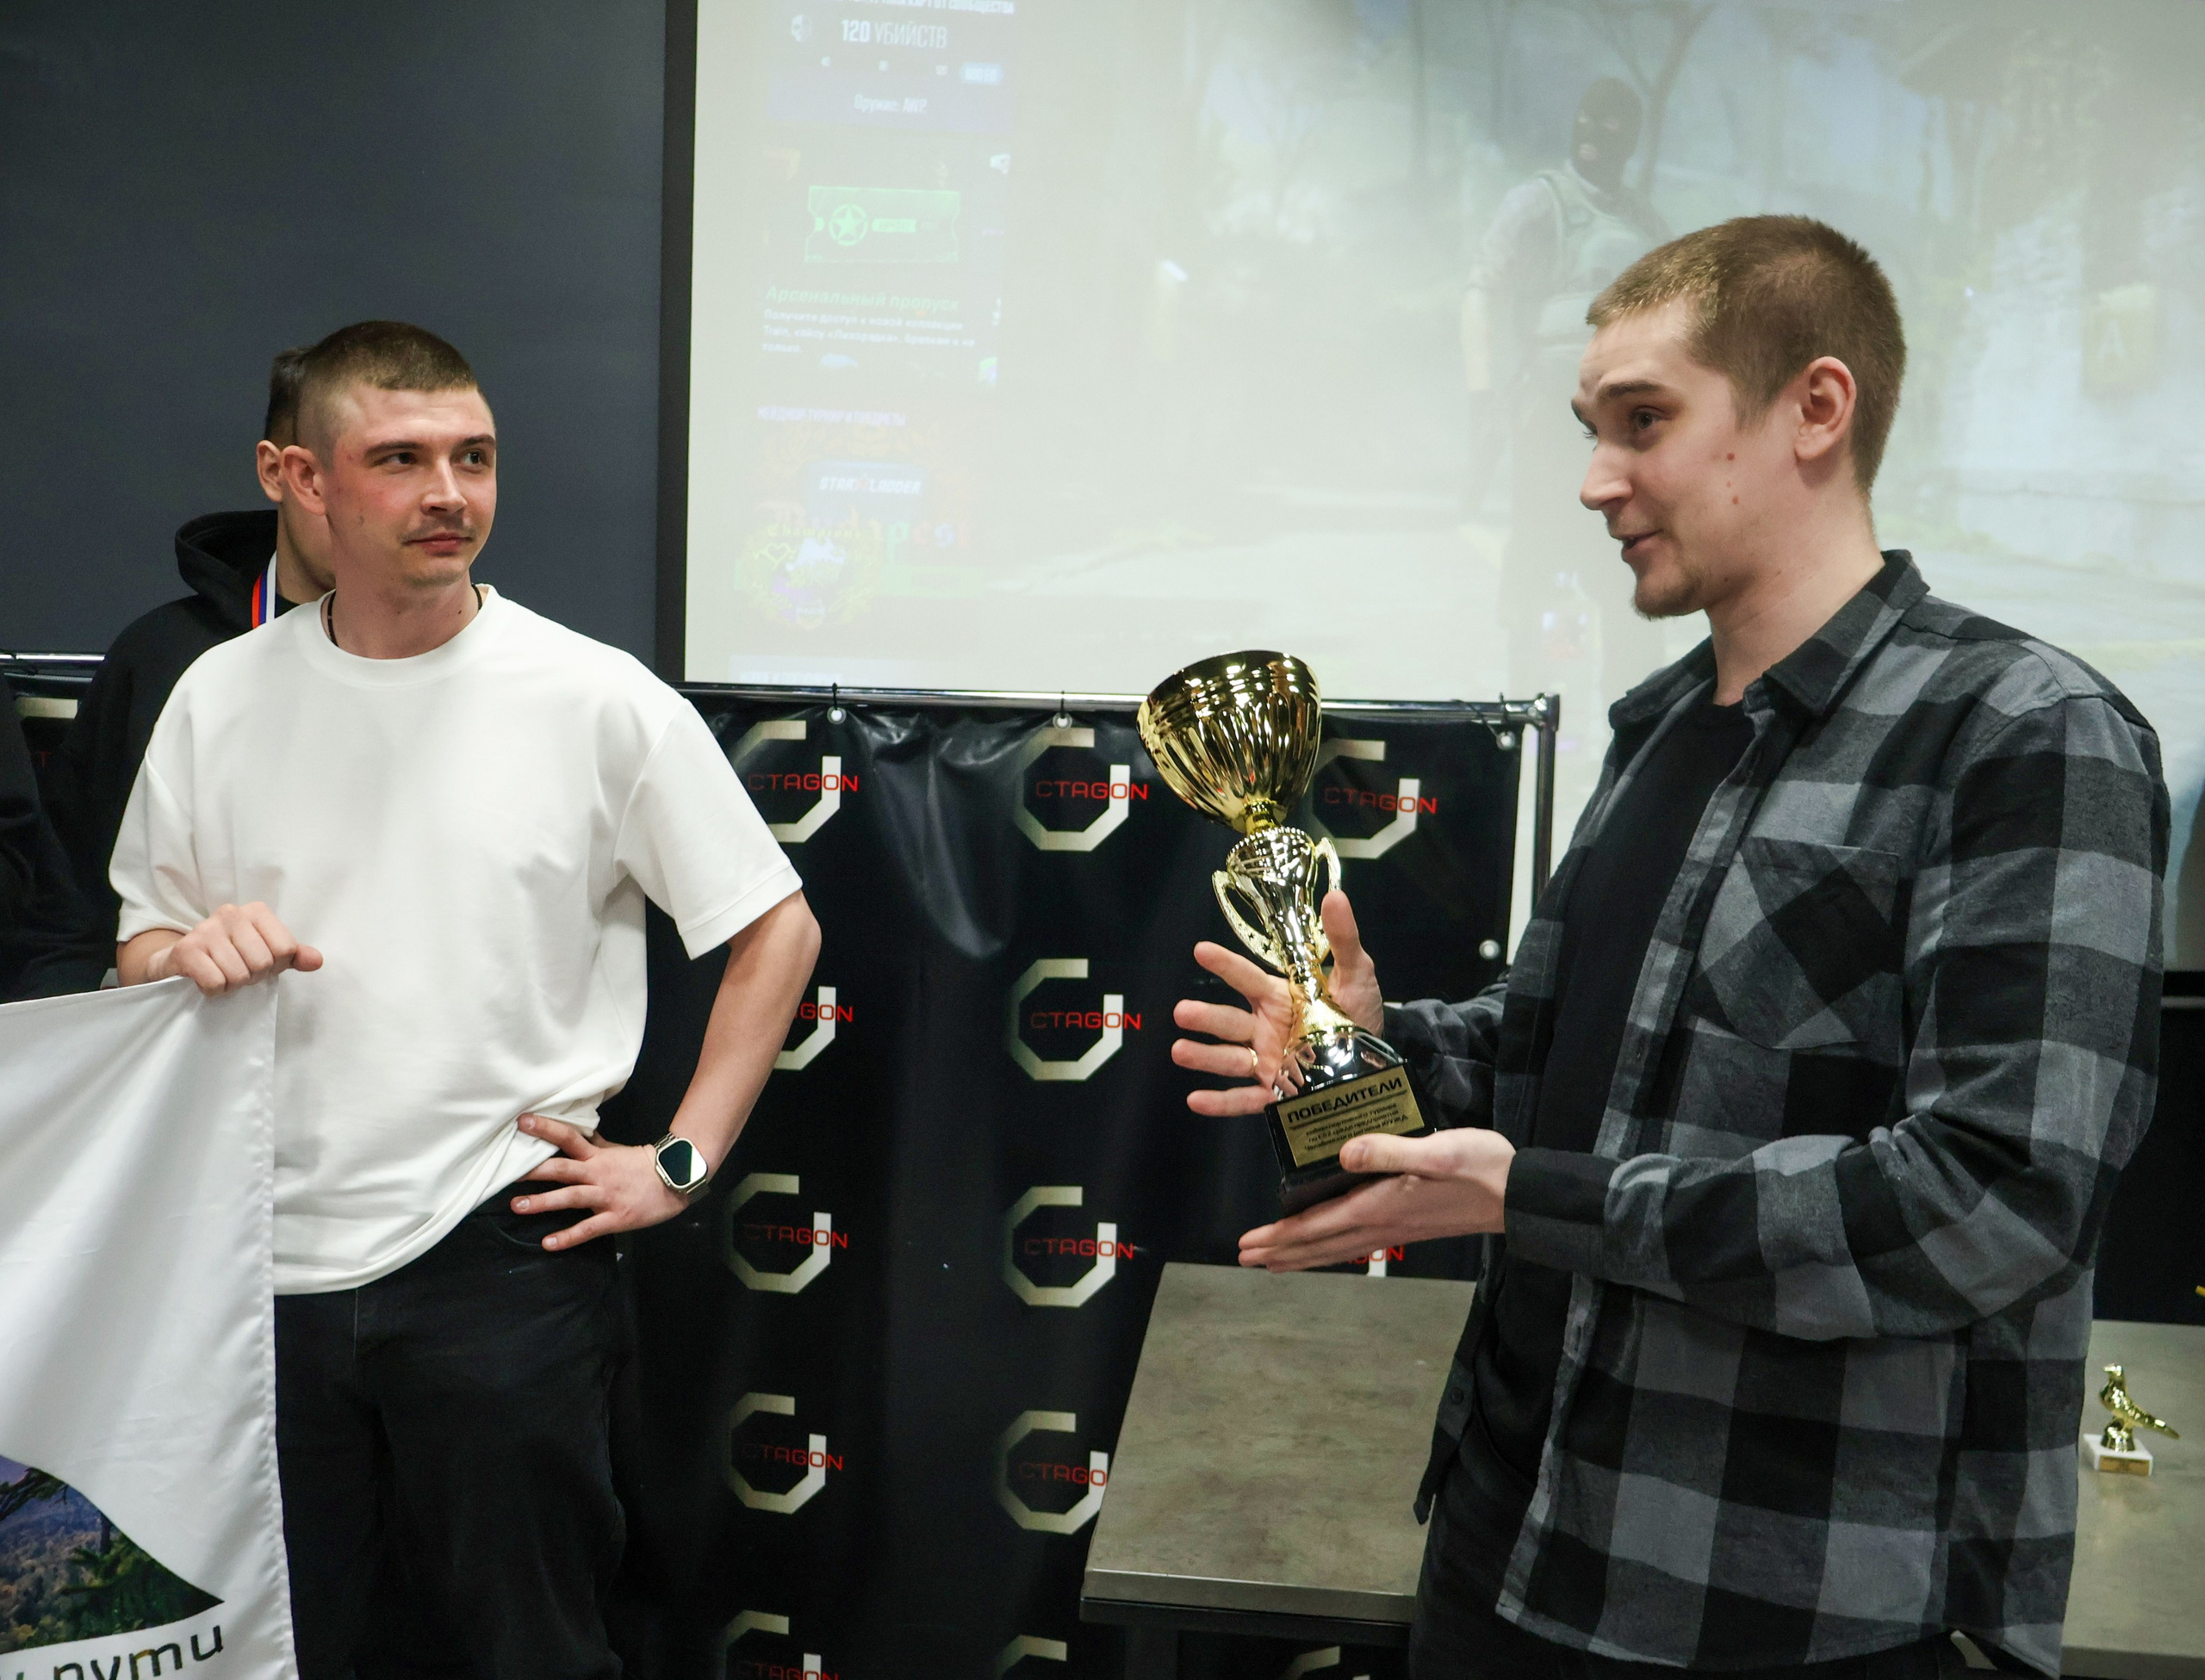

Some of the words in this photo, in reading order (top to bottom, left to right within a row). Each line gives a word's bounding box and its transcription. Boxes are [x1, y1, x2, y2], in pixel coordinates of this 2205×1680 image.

[842, 19, 871, 42] 120
[874, 20, 947, 49] УБИЙСТВ
[766, 286, 885, 307] Арсенальный
[890, 294, 959, 313] пропуск
[819, 312, 857, 325] доступ
[798, 1003, 854, 1022] GON
[1288, 1077, 1402, 1123] ПОБЕДИТЕЛИ
[1019, 1462, 1108, 1486] CTAGO
